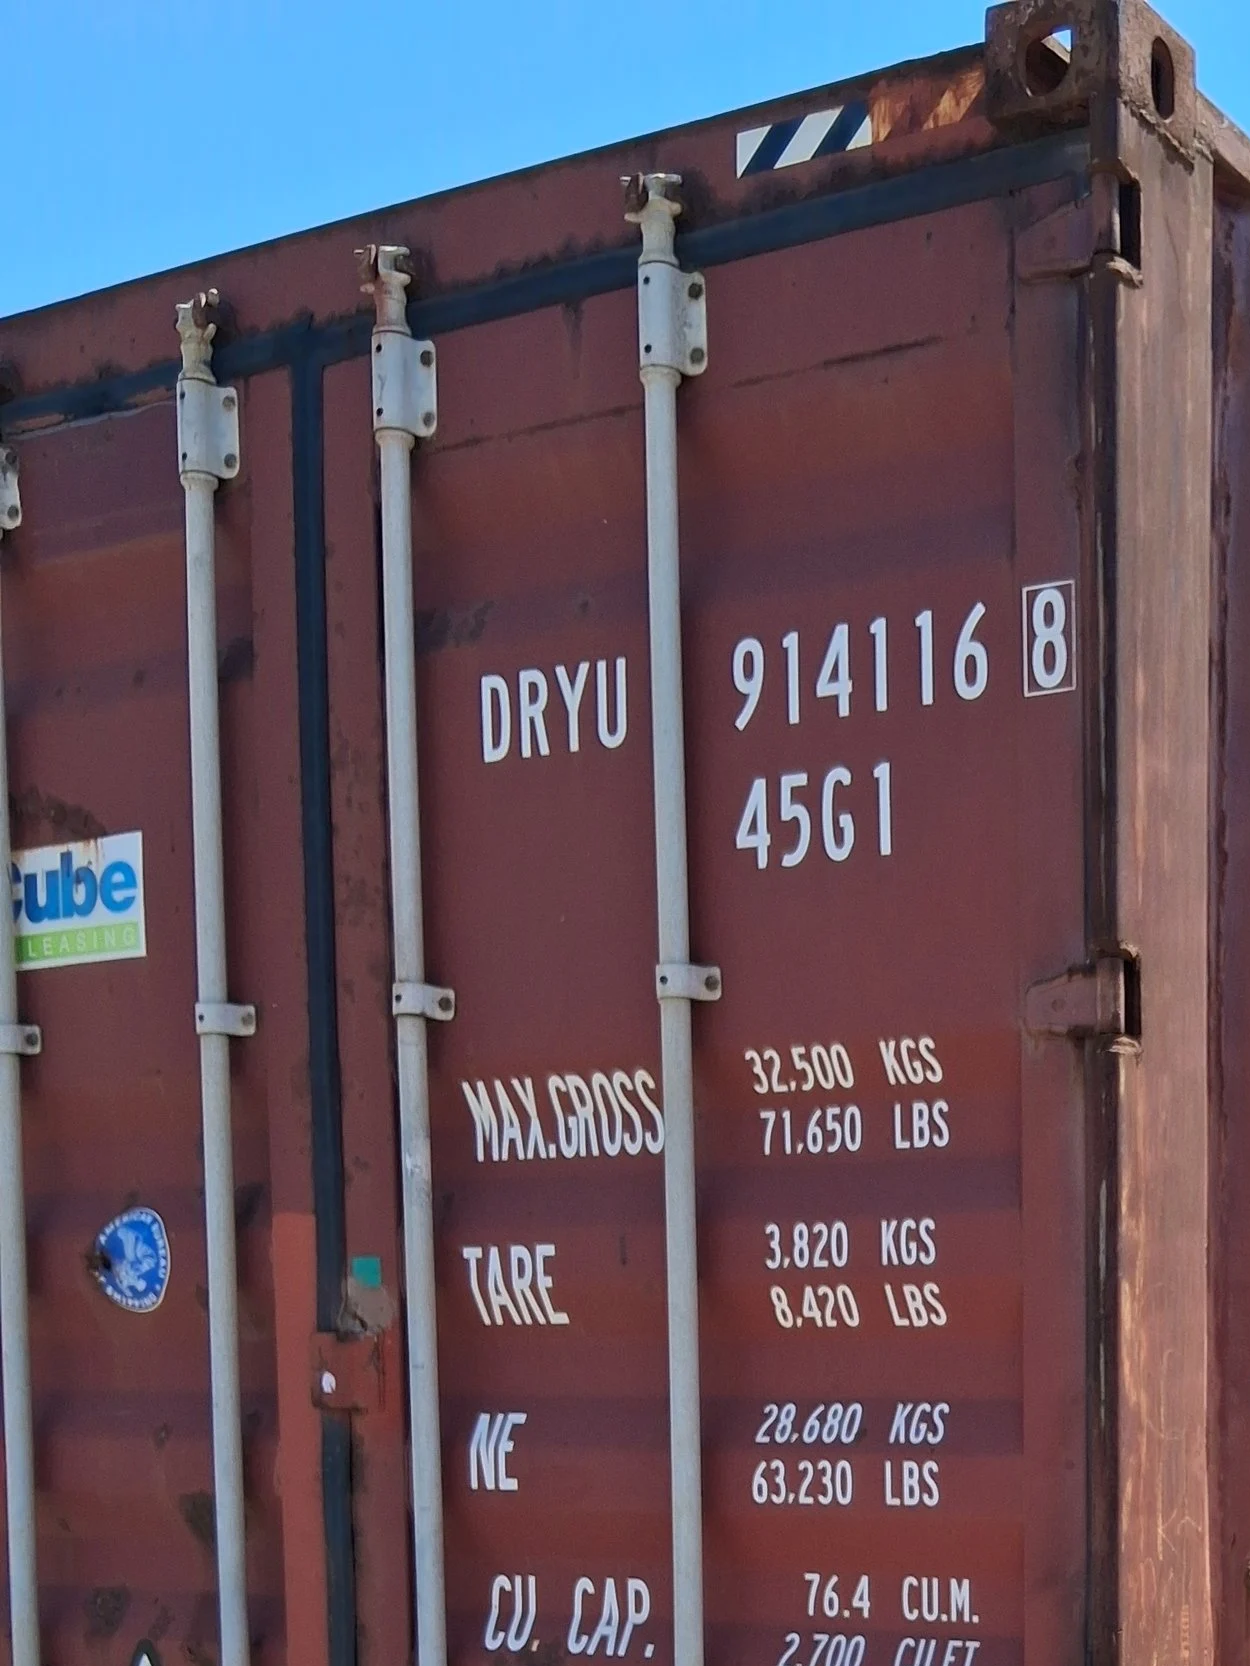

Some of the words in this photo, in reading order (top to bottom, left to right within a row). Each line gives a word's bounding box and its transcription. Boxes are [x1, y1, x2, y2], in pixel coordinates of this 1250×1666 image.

[481, 657, 627, 763] DRYU
[731, 601, 989, 732] 914116
[1030, 588, 1069, 690] 8
[734, 761, 892, 870] 45G1
[27, 926, 137, 958] LEASING
[461, 1069, 665, 1162] MAX.GROSS
[878, 1036, 944, 1087] KGS
[894, 1099, 951, 1150] LBS
[462, 1242, 570, 1326] TARE
[880, 1216, 937, 1267] KGS
[884, 1282, 949, 1328] LBS
[468, 1411, 529, 1491] NE
[888, 1401, 951, 1445] KGS
[884, 1459, 941, 1507] LBS
[566, 1576, 656, 1659] CAP.
[803, 1571, 871, 1619] 76.4
[901, 1575, 981, 1625] CU.M.
